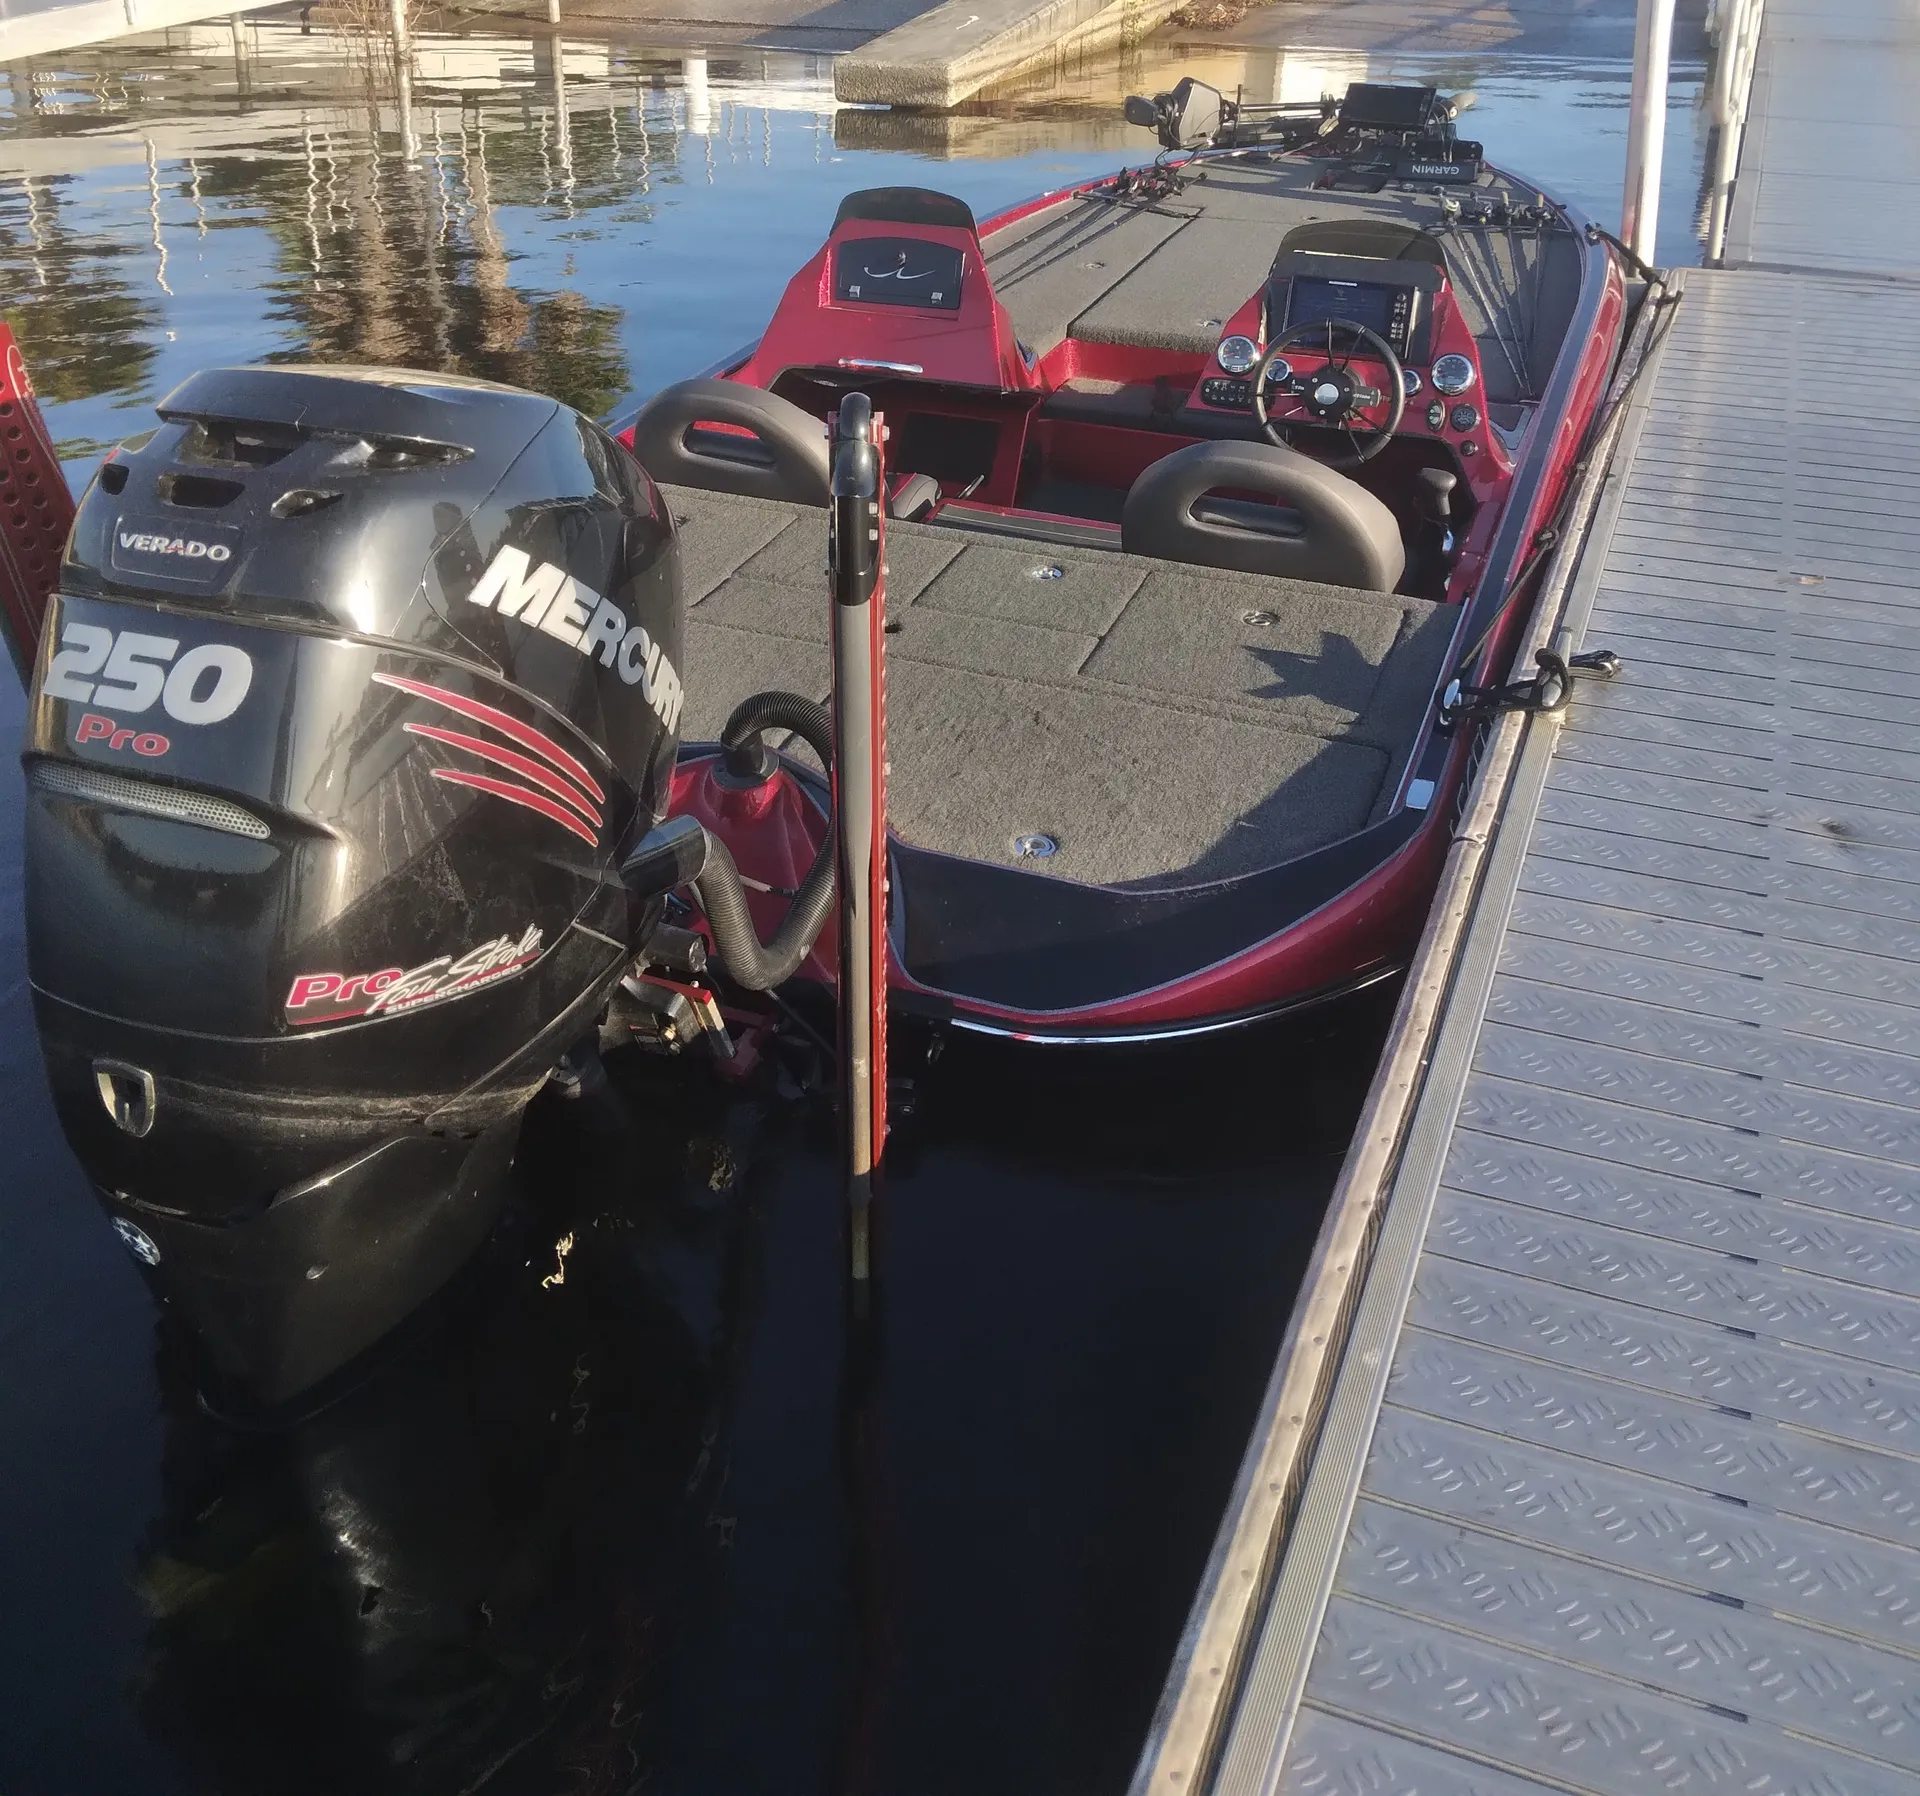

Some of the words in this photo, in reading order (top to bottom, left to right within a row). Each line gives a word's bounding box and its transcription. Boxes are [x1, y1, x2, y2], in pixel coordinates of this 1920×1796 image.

[1412, 165, 1459, 174] GARMIN
[119, 532, 230, 561] VERADO
[43, 622, 253, 725] 250
[75, 713, 170, 757] Pro
[285, 968, 405, 1009] Pro
[383, 963, 523, 1015] SUPERCHARGED
